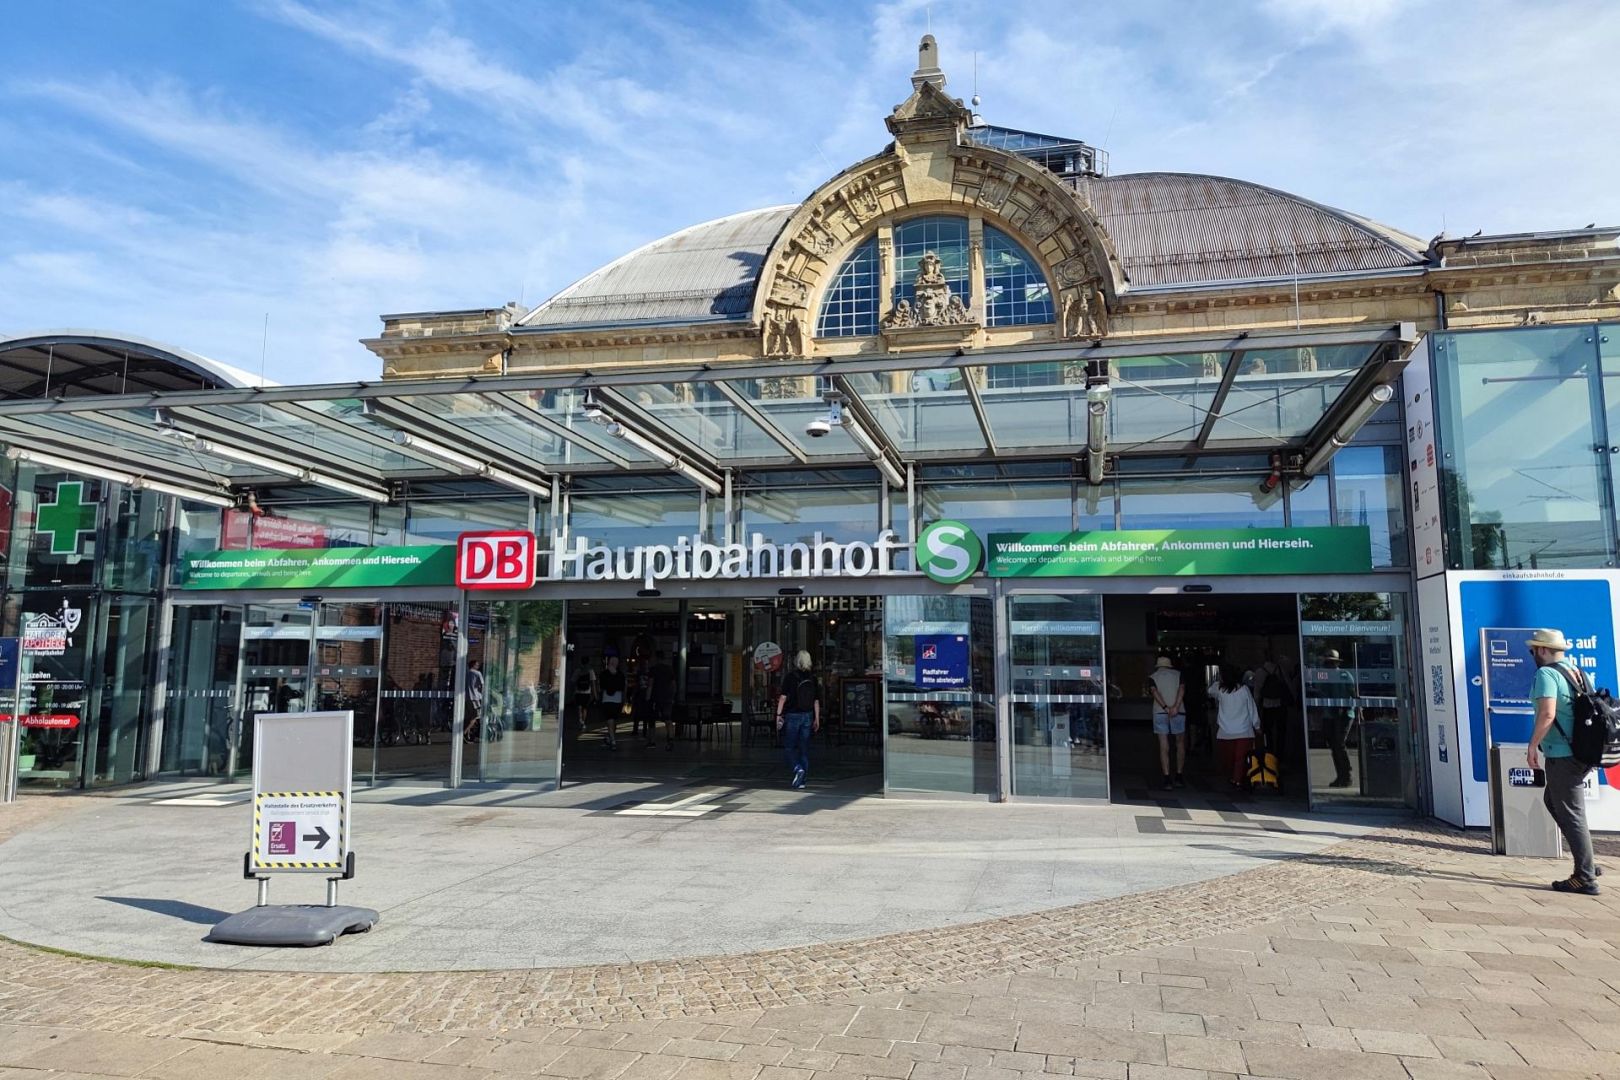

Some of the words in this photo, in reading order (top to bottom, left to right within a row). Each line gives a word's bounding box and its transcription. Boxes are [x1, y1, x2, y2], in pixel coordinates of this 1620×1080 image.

[996, 542, 1067, 553] Willkommen
[1069, 541, 1098, 552] beim
[1100, 540, 1159, 552] Abfahren,
[1161, 540, 1230, 551] Ankommen
[1232, 538, 1253, 550] und
[1258, 537, 1314, 549] Hiersein.
[190, 559, 243, 569] Willkommen
[244, 558, 267, 568] beim
[267, 558, 310, 568] Abfahren,
[312, 557, 361, 566] Ankommen
[362, 556, 380, 565] und
[381, 554, 422, 565] Hiersein.
[466, 541, 523, 579] DB
[551, 529, 894, 590] Hauptbahnhof
[996, 556, 1028, 564] Welcome
[1029, 556, 1037, 564] to
[1080, 555, 1107, 563] arrivals
[1108, 555, 1123, 563] and
[1123, 555, 1146, 565] being
[795, 596, 859, 612] COFFEE
[1311, 624, 1348, 632] Welcome!
[24, 640, 66, 649] APOTHEKE
[1576, 635, 1597, 649] auf
[1580, 654, 1597, 667] im
[25, 716, 70, 726] Abholautomat
